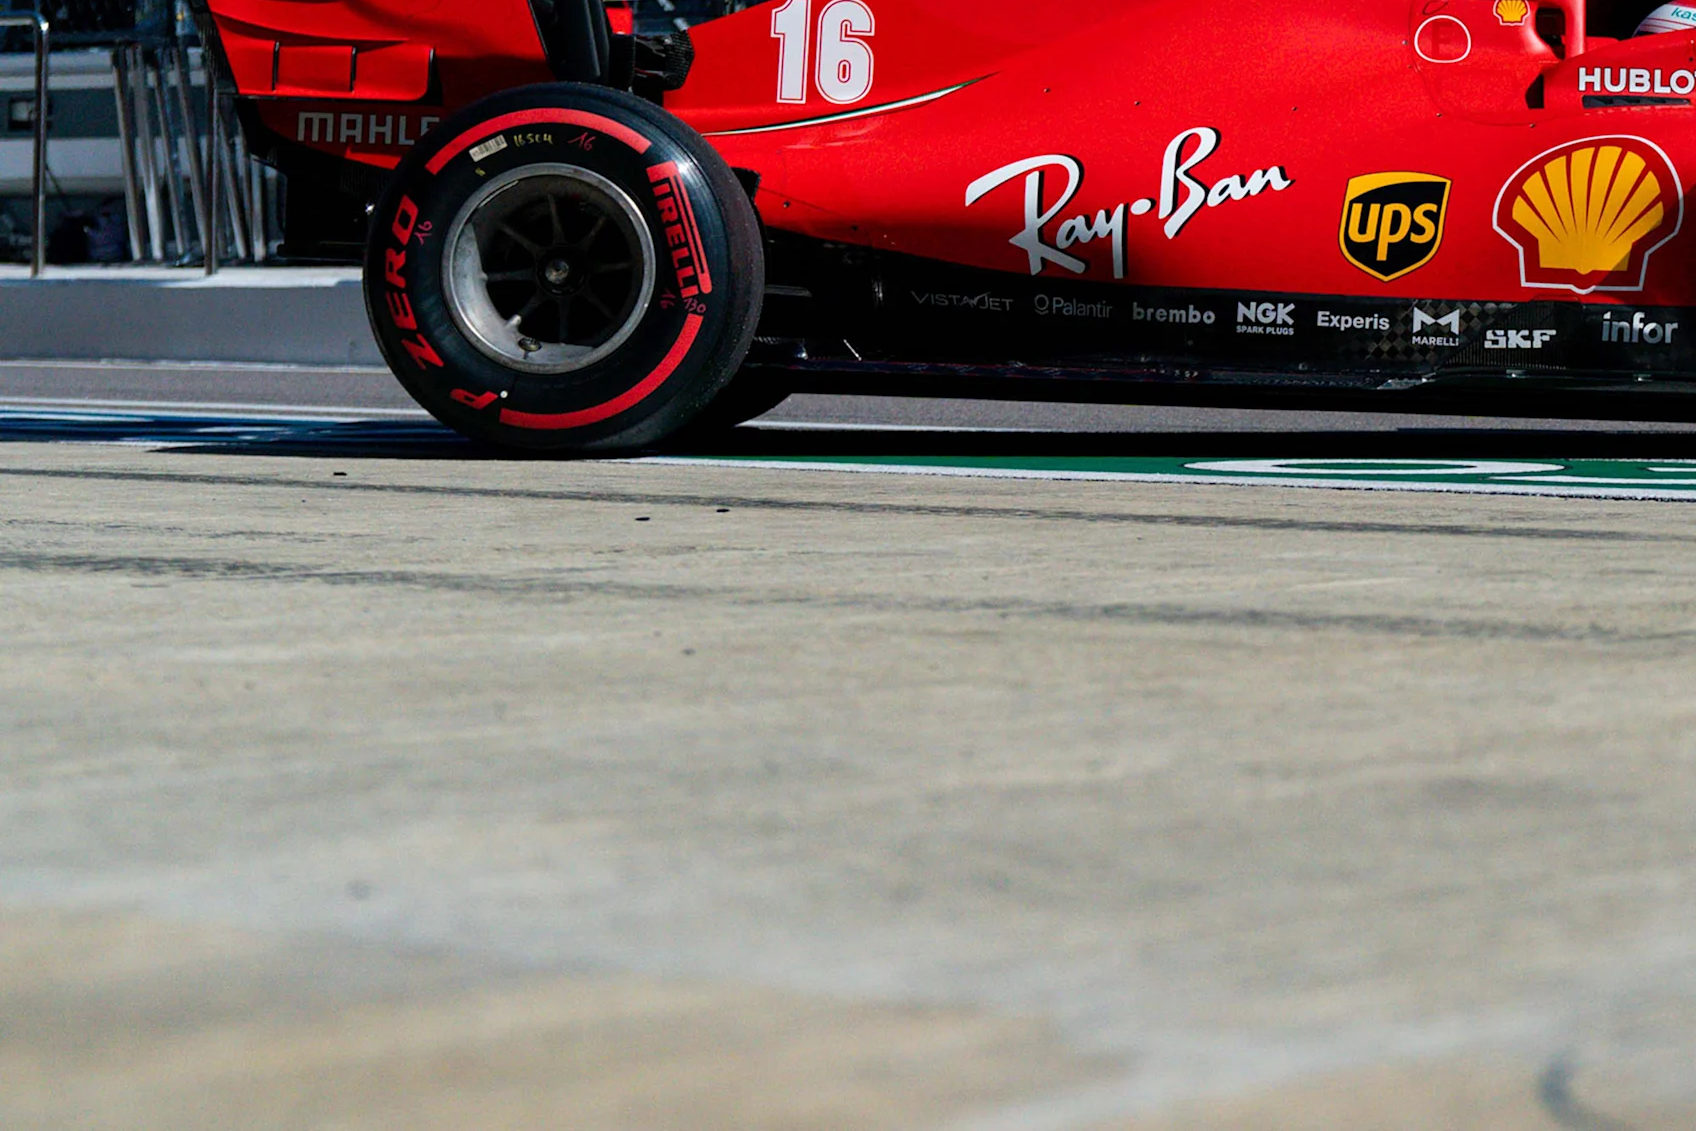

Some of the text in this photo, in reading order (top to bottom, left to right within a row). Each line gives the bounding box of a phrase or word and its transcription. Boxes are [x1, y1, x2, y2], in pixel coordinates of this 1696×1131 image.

[566, 131, 597, 151] 16
[413, 220, 433, 245] 16
[646, 160, 713, 298] PIRELLI
[1348, 203, 1438, 261] ups
[385, 194, 499, 410] P ZERO
[1052, 296, 1113, 319] Palantir
[1132, 302, 1216, 325] brembo
[1236, 301, 1296, 326] NGK
[1236, 325, 1295, 336] SPARK PLUGS
[1316, 310, 1391, 331] Experis
[1601, 310, 1679, 344] infor
[1411, 335, 1460, 347] MARELLI
[1484, 329, 1558, 350] SKF
